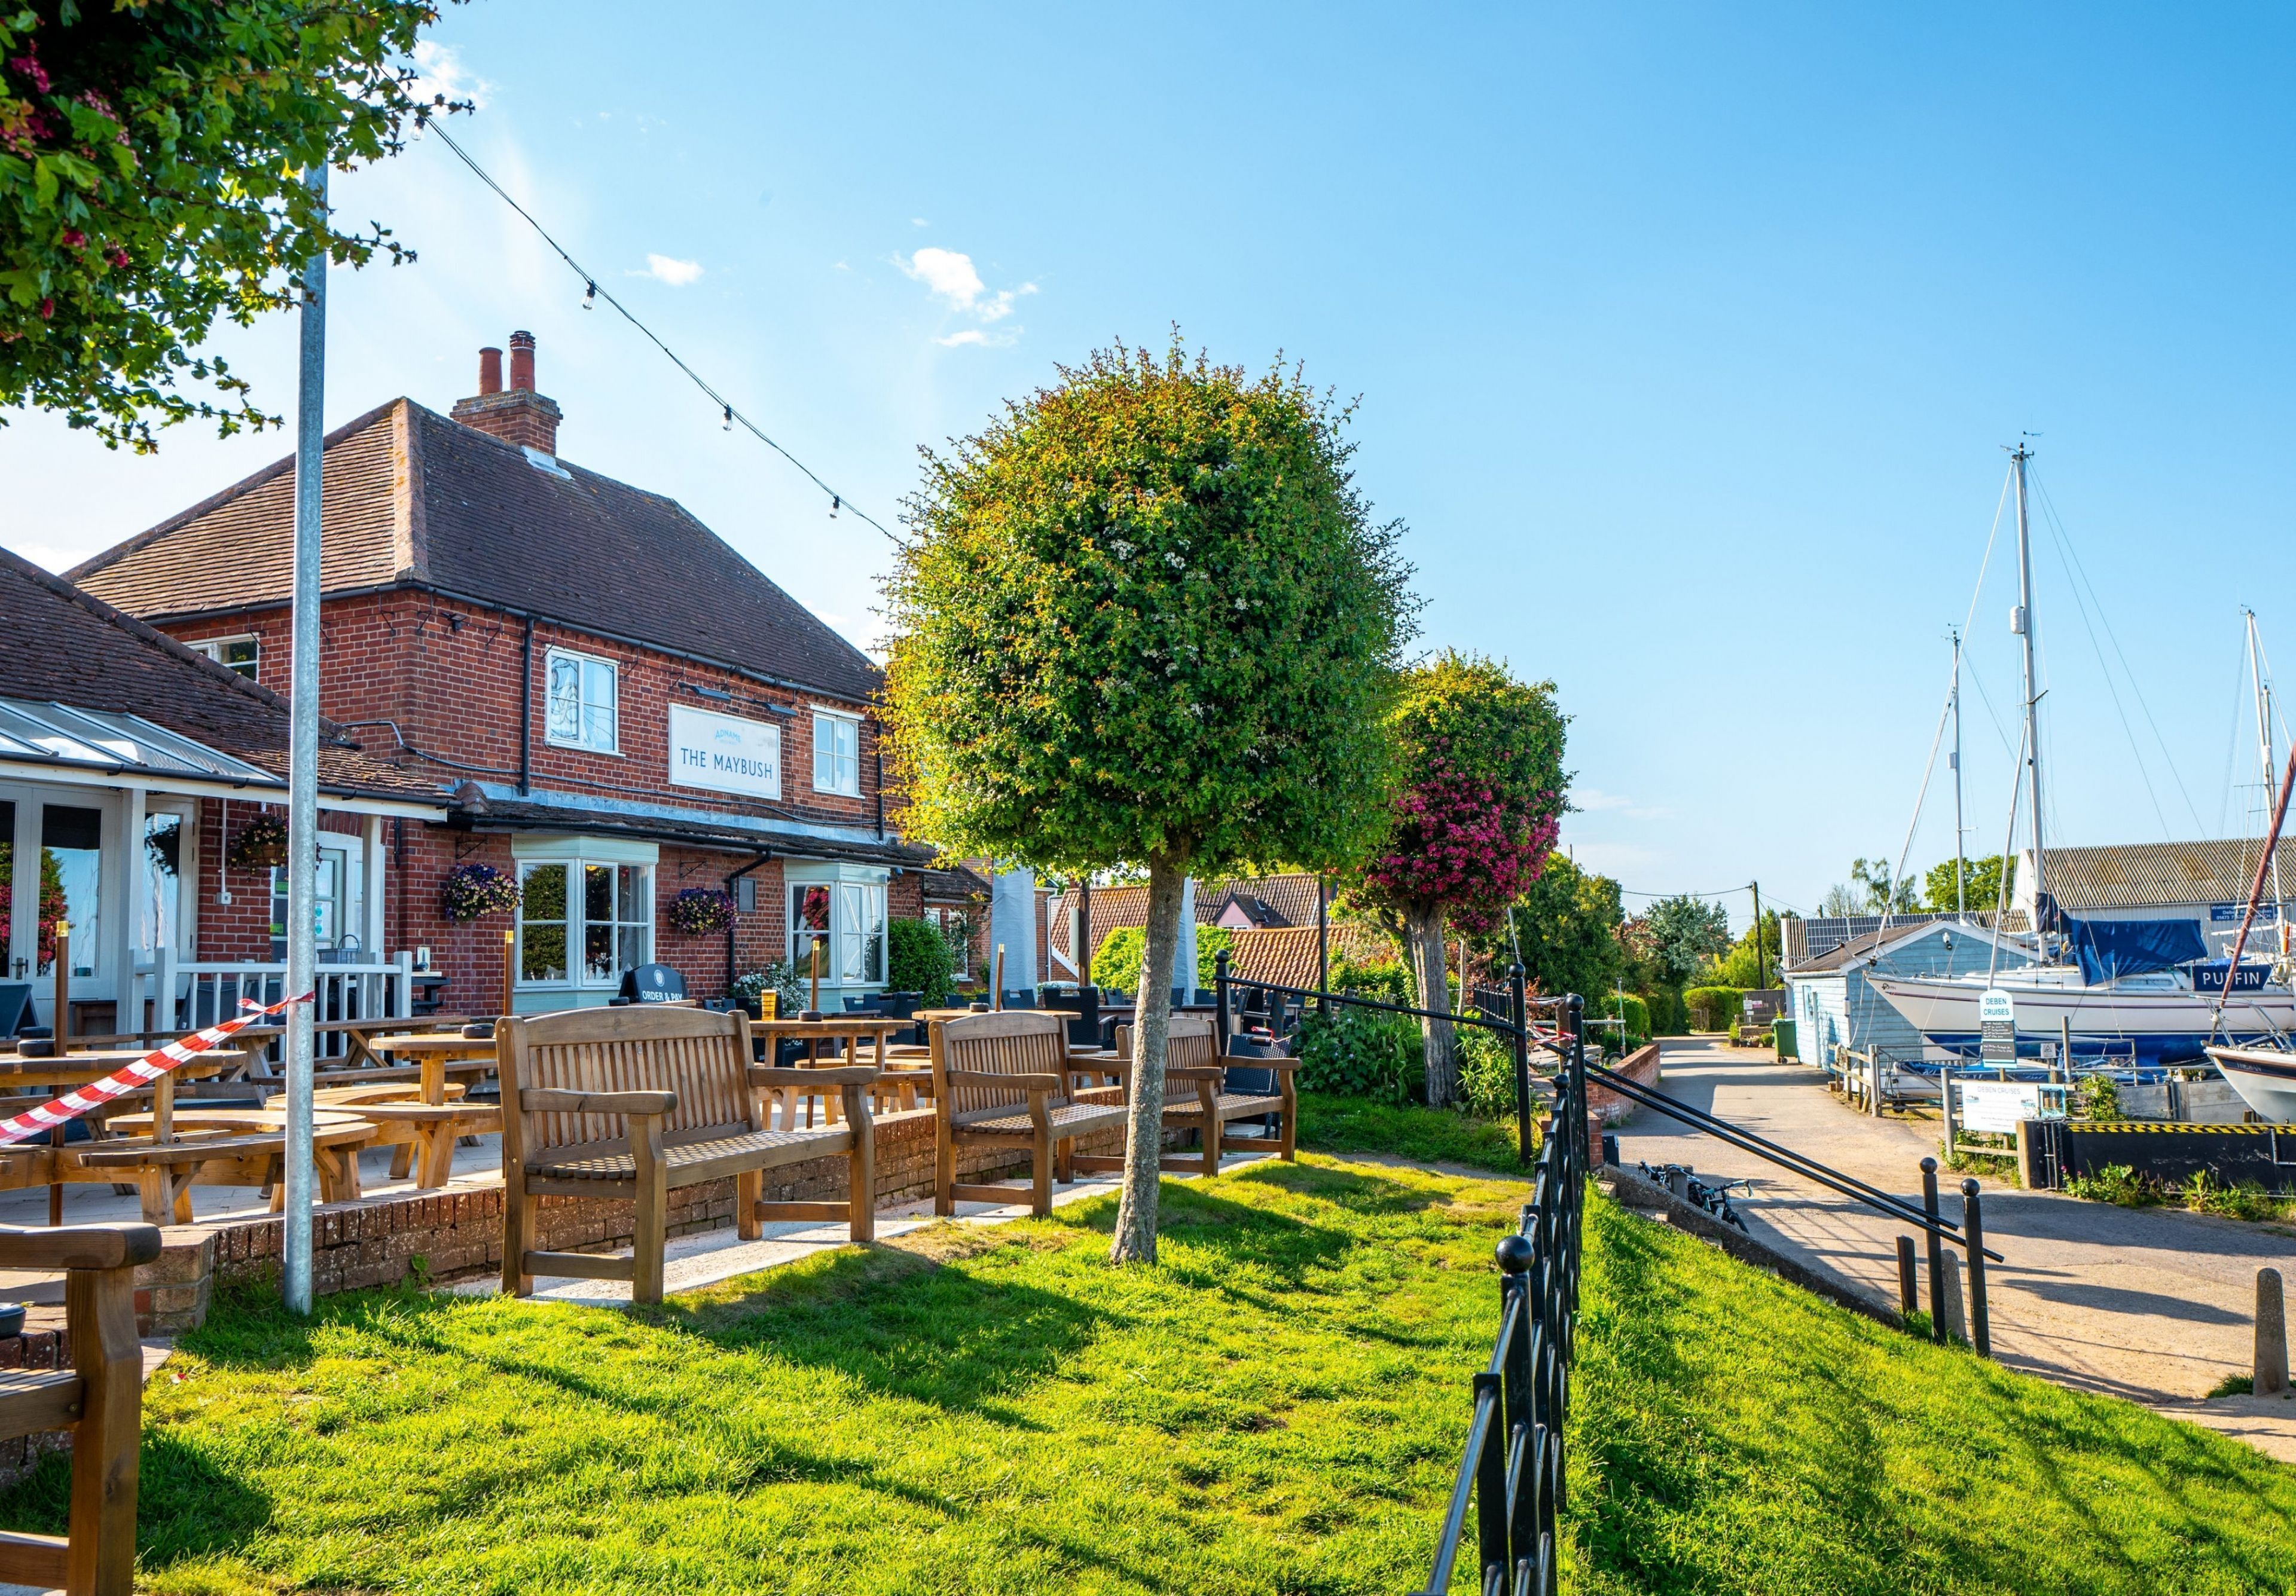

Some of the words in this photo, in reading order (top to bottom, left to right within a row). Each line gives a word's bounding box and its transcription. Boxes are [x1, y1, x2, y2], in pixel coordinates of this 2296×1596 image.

[680, 747, 706, 768] THE
[714, 754, 773, 779] MAYBUSH
[642, 990, 664, 1001] ORDER
[664, 992, 670, 1001] &
[670, 993, 682, 1001] PAY
